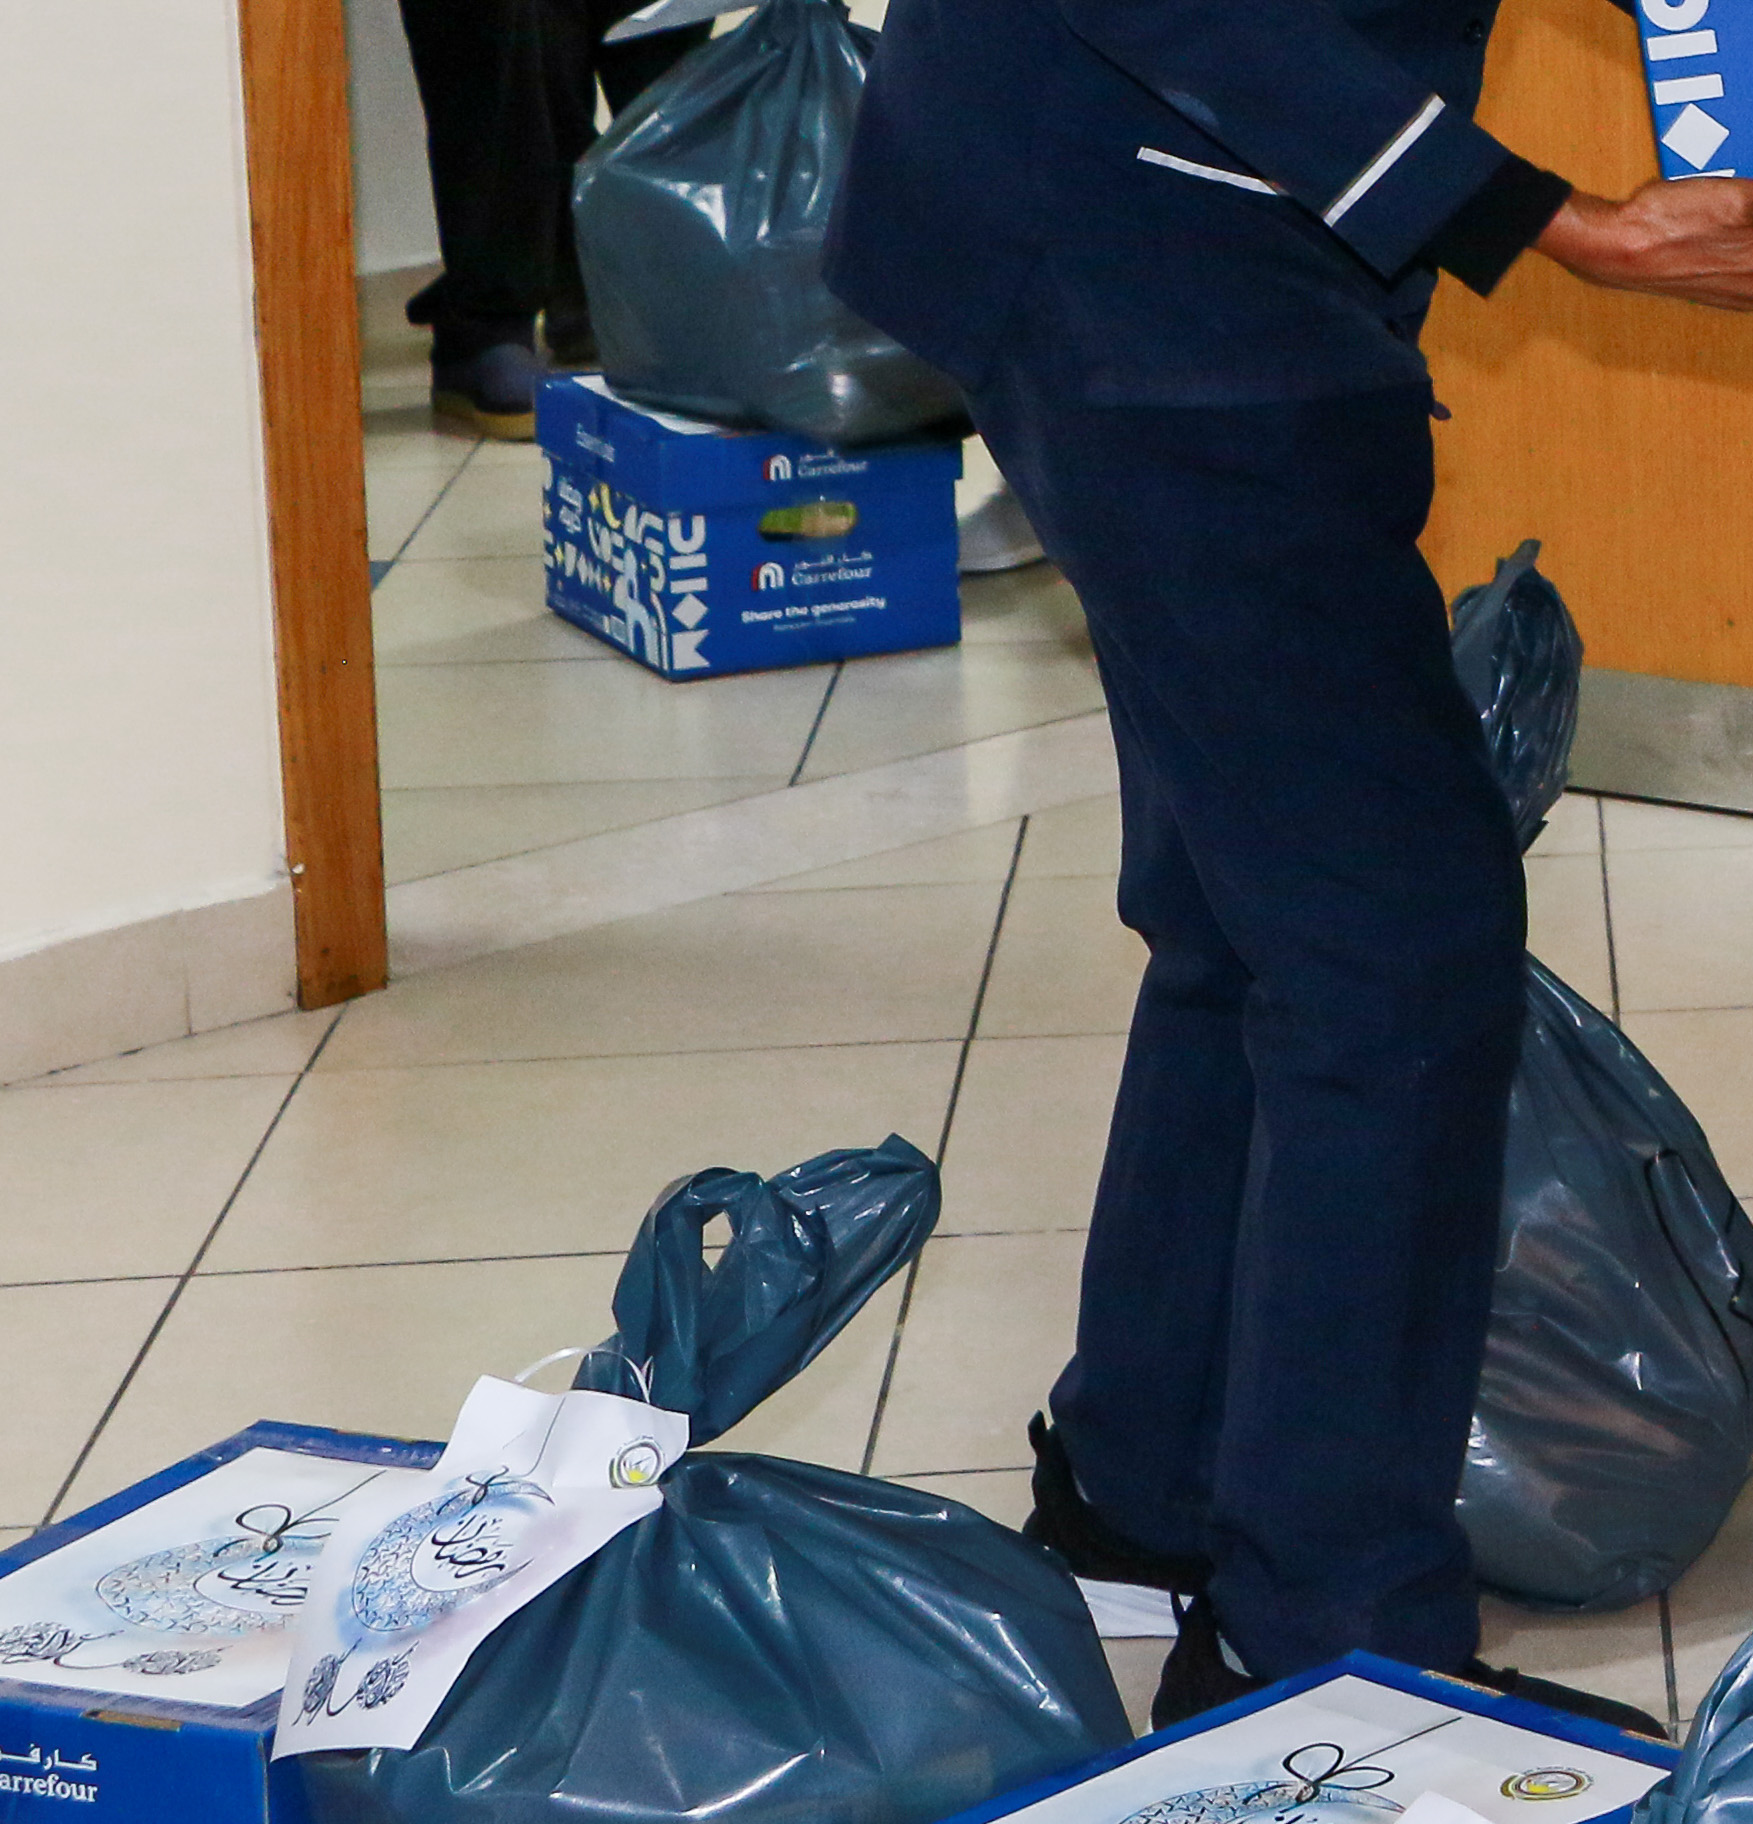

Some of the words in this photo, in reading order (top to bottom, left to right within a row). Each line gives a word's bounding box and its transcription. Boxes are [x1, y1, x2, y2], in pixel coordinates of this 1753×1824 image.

[791, 567, 873, 586] Carrefour
[741, 610, 783, 624] Share
[0, 1773, 98, 1803] arrefour
